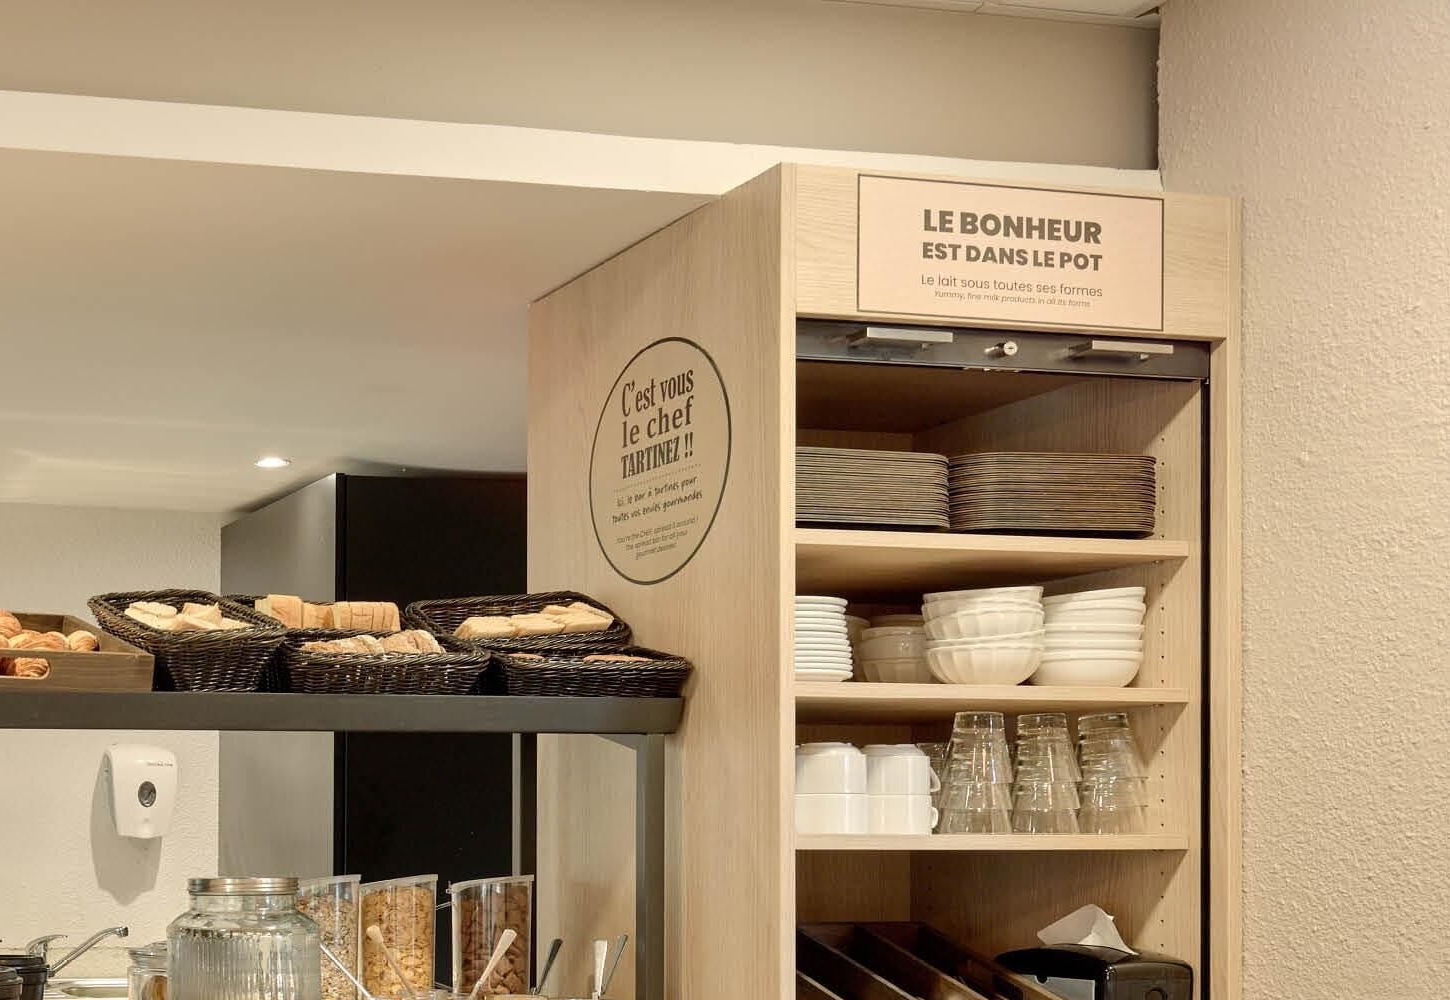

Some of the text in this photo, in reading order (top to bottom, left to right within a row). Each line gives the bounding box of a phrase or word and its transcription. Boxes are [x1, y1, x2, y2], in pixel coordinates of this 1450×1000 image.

[923, 208, 1102, 244] LE BONHEUR
[922, 242, 1103, 271] EST DANS LE POT
[921, 274, 1103, 297] Le lait sous toutes ses formes
[660, 369, 694, 402] vous
[622, 395, 694, 449] le chef
[621, 432, 694, 479] TARTINEZ !!
[681, 476, 698, 491] pour
[612, 490, 703, 525] toutes vos envies gourmandes
